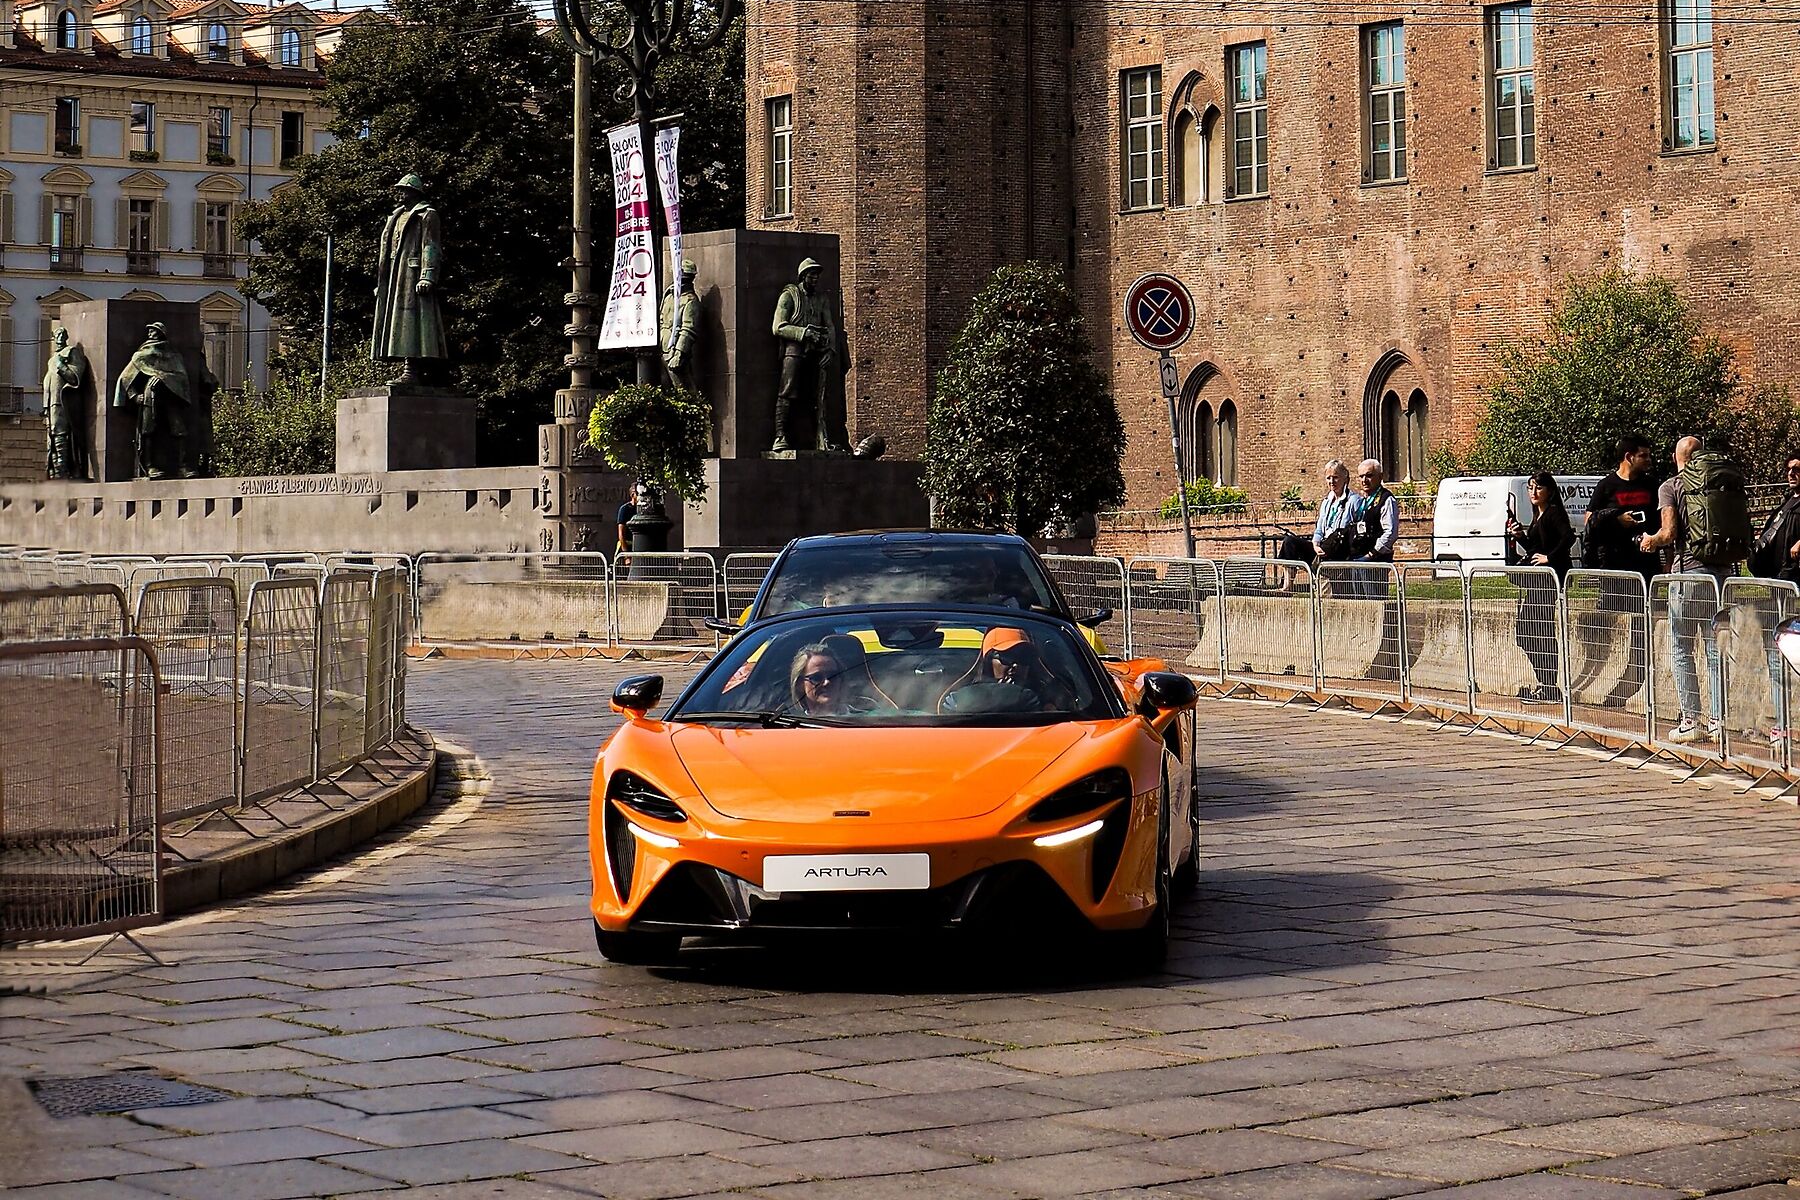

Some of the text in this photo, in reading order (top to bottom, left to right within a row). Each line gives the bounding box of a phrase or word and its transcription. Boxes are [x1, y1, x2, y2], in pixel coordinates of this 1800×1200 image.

[612, 136, 639, 155] SALONE
[617, 234, 646, 252] SALONE
[610, 281, 647, 301] 2024
[804, 866, 888, 878] ARTURA
